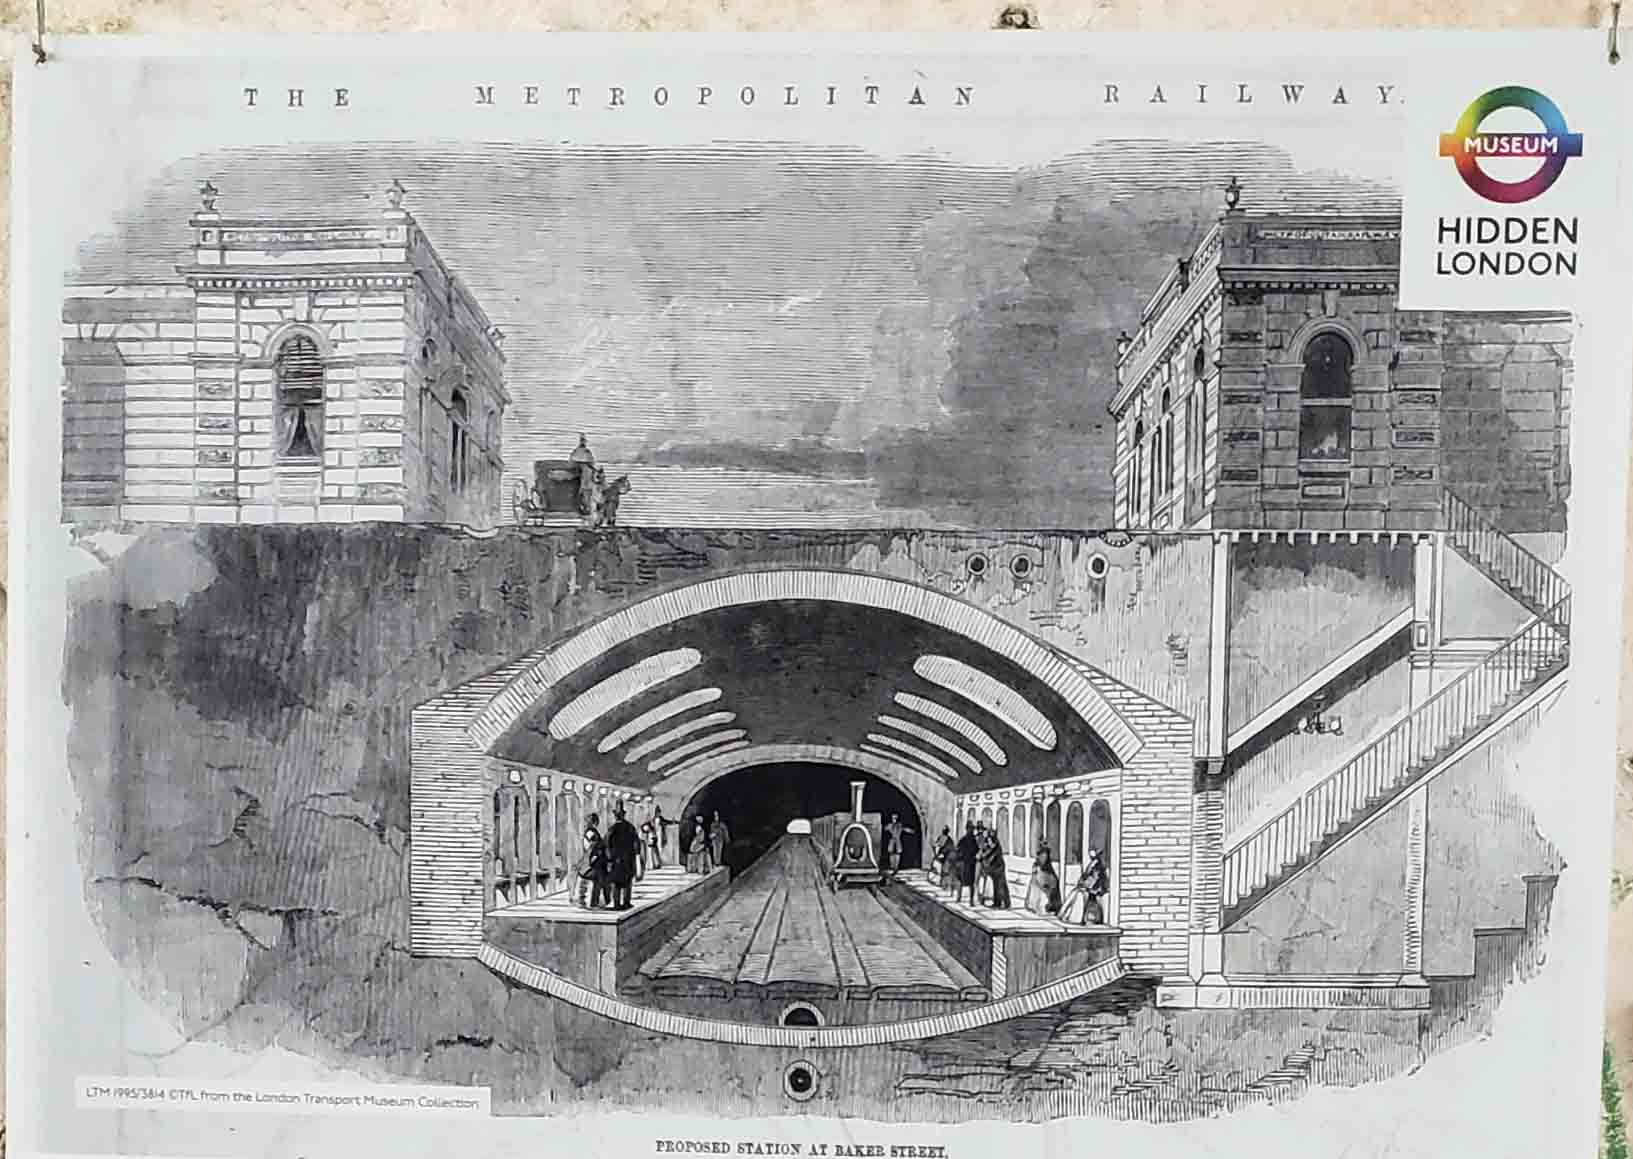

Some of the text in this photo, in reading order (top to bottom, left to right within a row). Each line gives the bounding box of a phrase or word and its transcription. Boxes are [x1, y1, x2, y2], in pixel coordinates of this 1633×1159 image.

[243, 87, 350, 107] THE
[473, 84, 976, 108] METROPOLITAN
[1463, 136, 1559, 154] MUSEUM
[1437, 216, 1579, 245] HIDDEN
[1435, 250, 1578, 276] LONDON
[85, 1086, 111, 1099] LTM
[200, 1089, 231, 1102] from
[232, 1091, 254, 1103] the
[255, 1092, 300, 1104] London
[303, 1092, 362, 1107] Transport
[363, 1095, 416, 1107] Museum
[417, 1095, 480, 1110] Collection
[655, 1140, 731, 1154] PROPOSED
[736, 1141, 802, 1156] STATION
[807, 1143, 829, 1157] AT
[834, 1144, 886, 1158] BAKER
